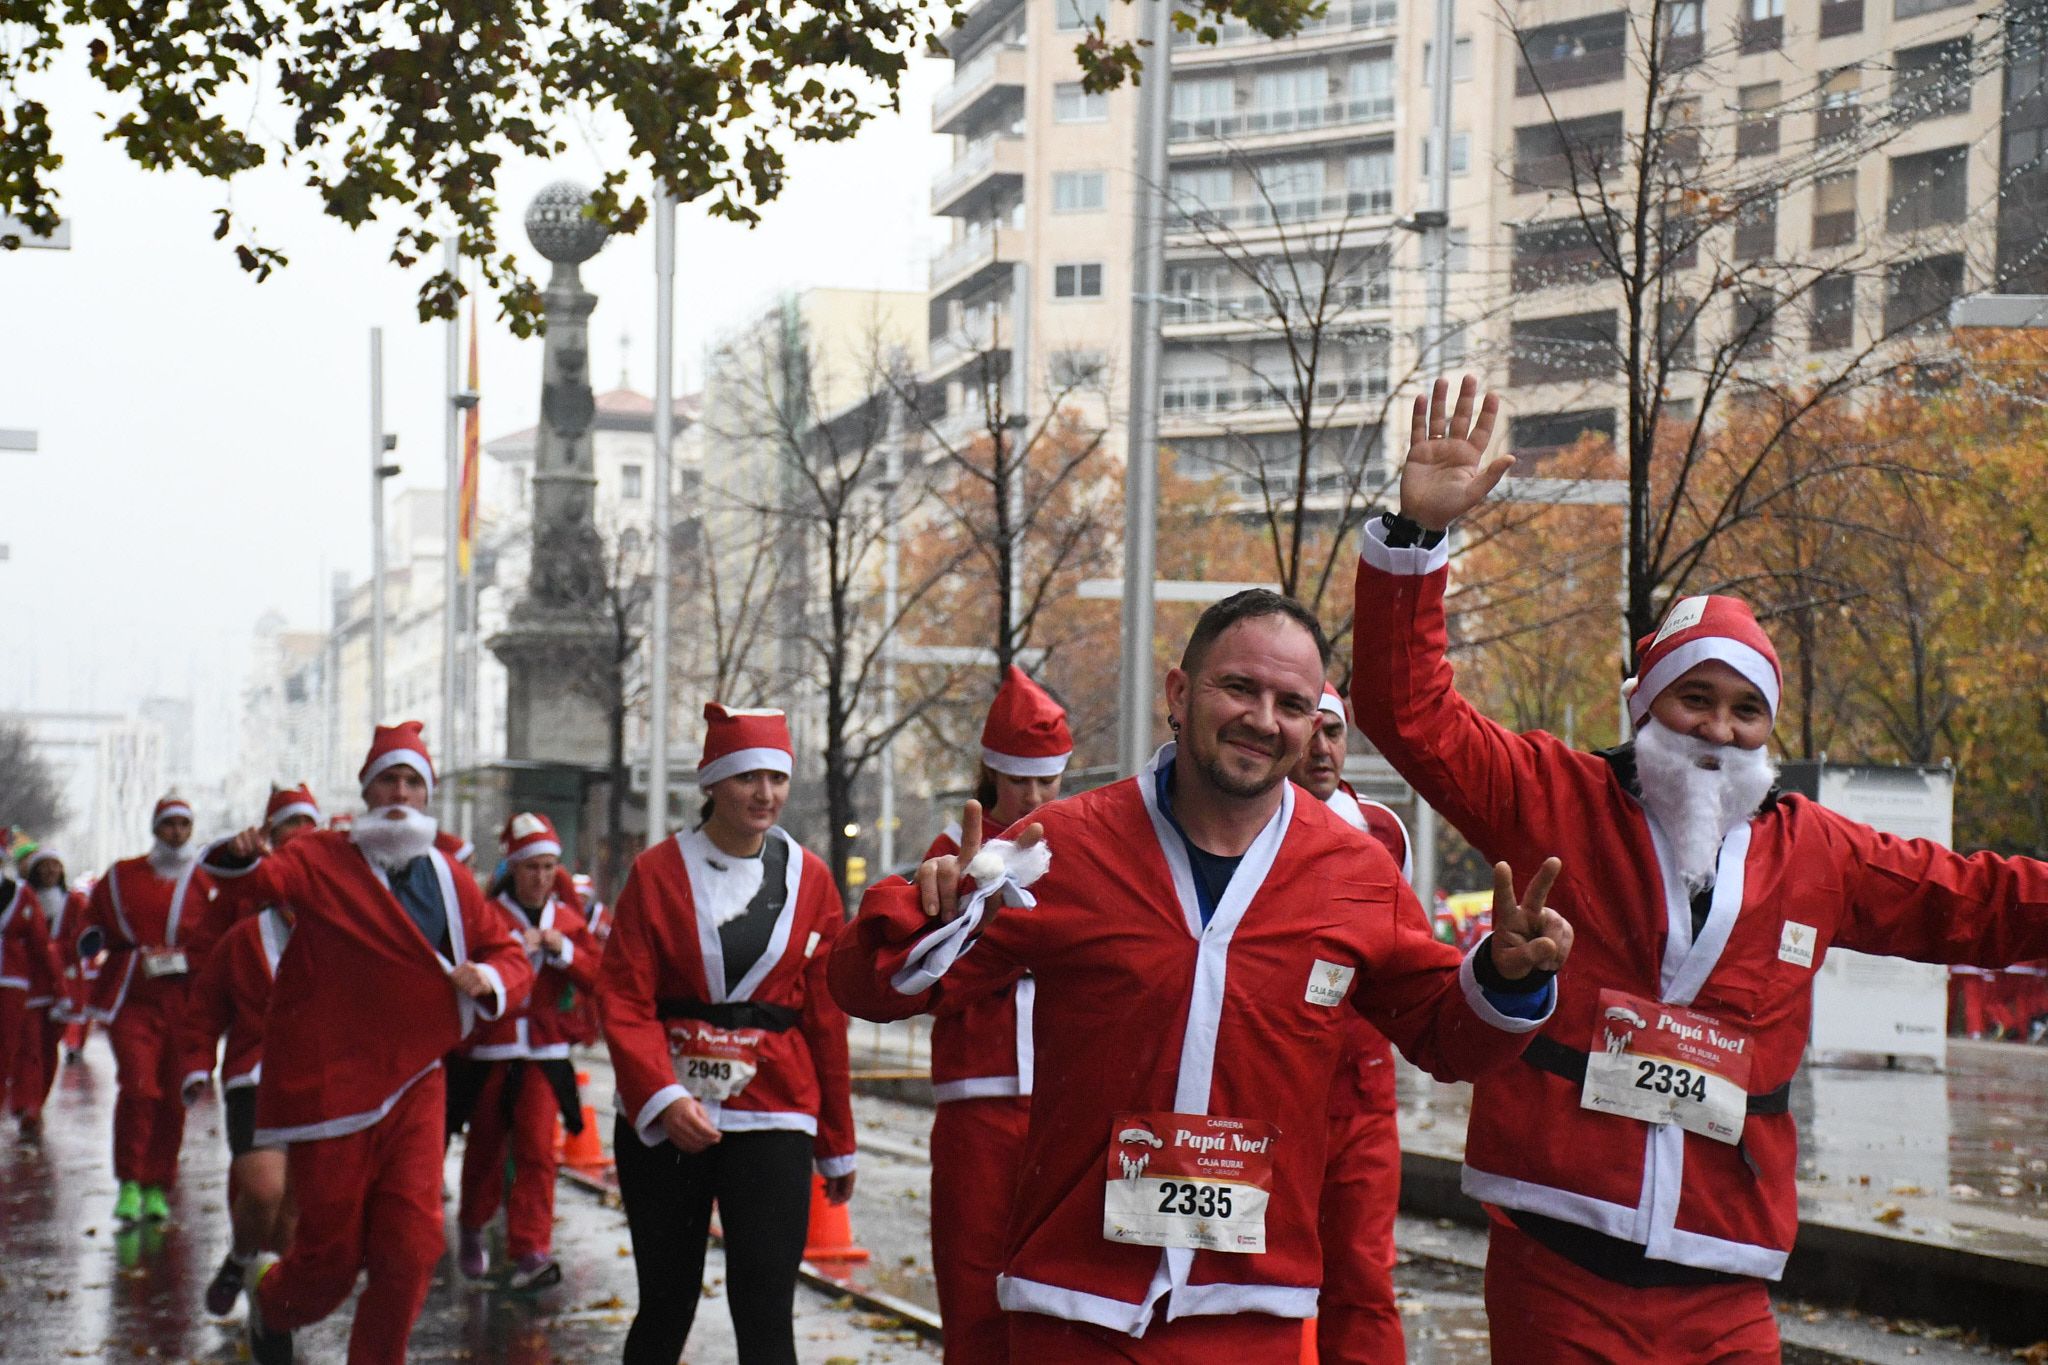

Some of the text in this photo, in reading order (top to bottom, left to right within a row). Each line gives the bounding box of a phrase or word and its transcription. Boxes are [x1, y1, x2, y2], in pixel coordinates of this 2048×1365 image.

[1686, 1011, 1719, 1026] CARRERA
[1656, 1014, 1745, 1054] Papá Noel
[1677, 1043, 1720, 1062] CAJA RURAL
[688, 1060, 731, 1080] 2943
[1635, 1061, 1706, 1102] 2334
[1207, 1120, 1243, 1129] CARRERA
[1174, 1129, 1269, 1154] Papá Noel
[1197, 1158, 1244, 1168] CAJA RURAL
[1158, 1182, 1232, 1218] 2335
